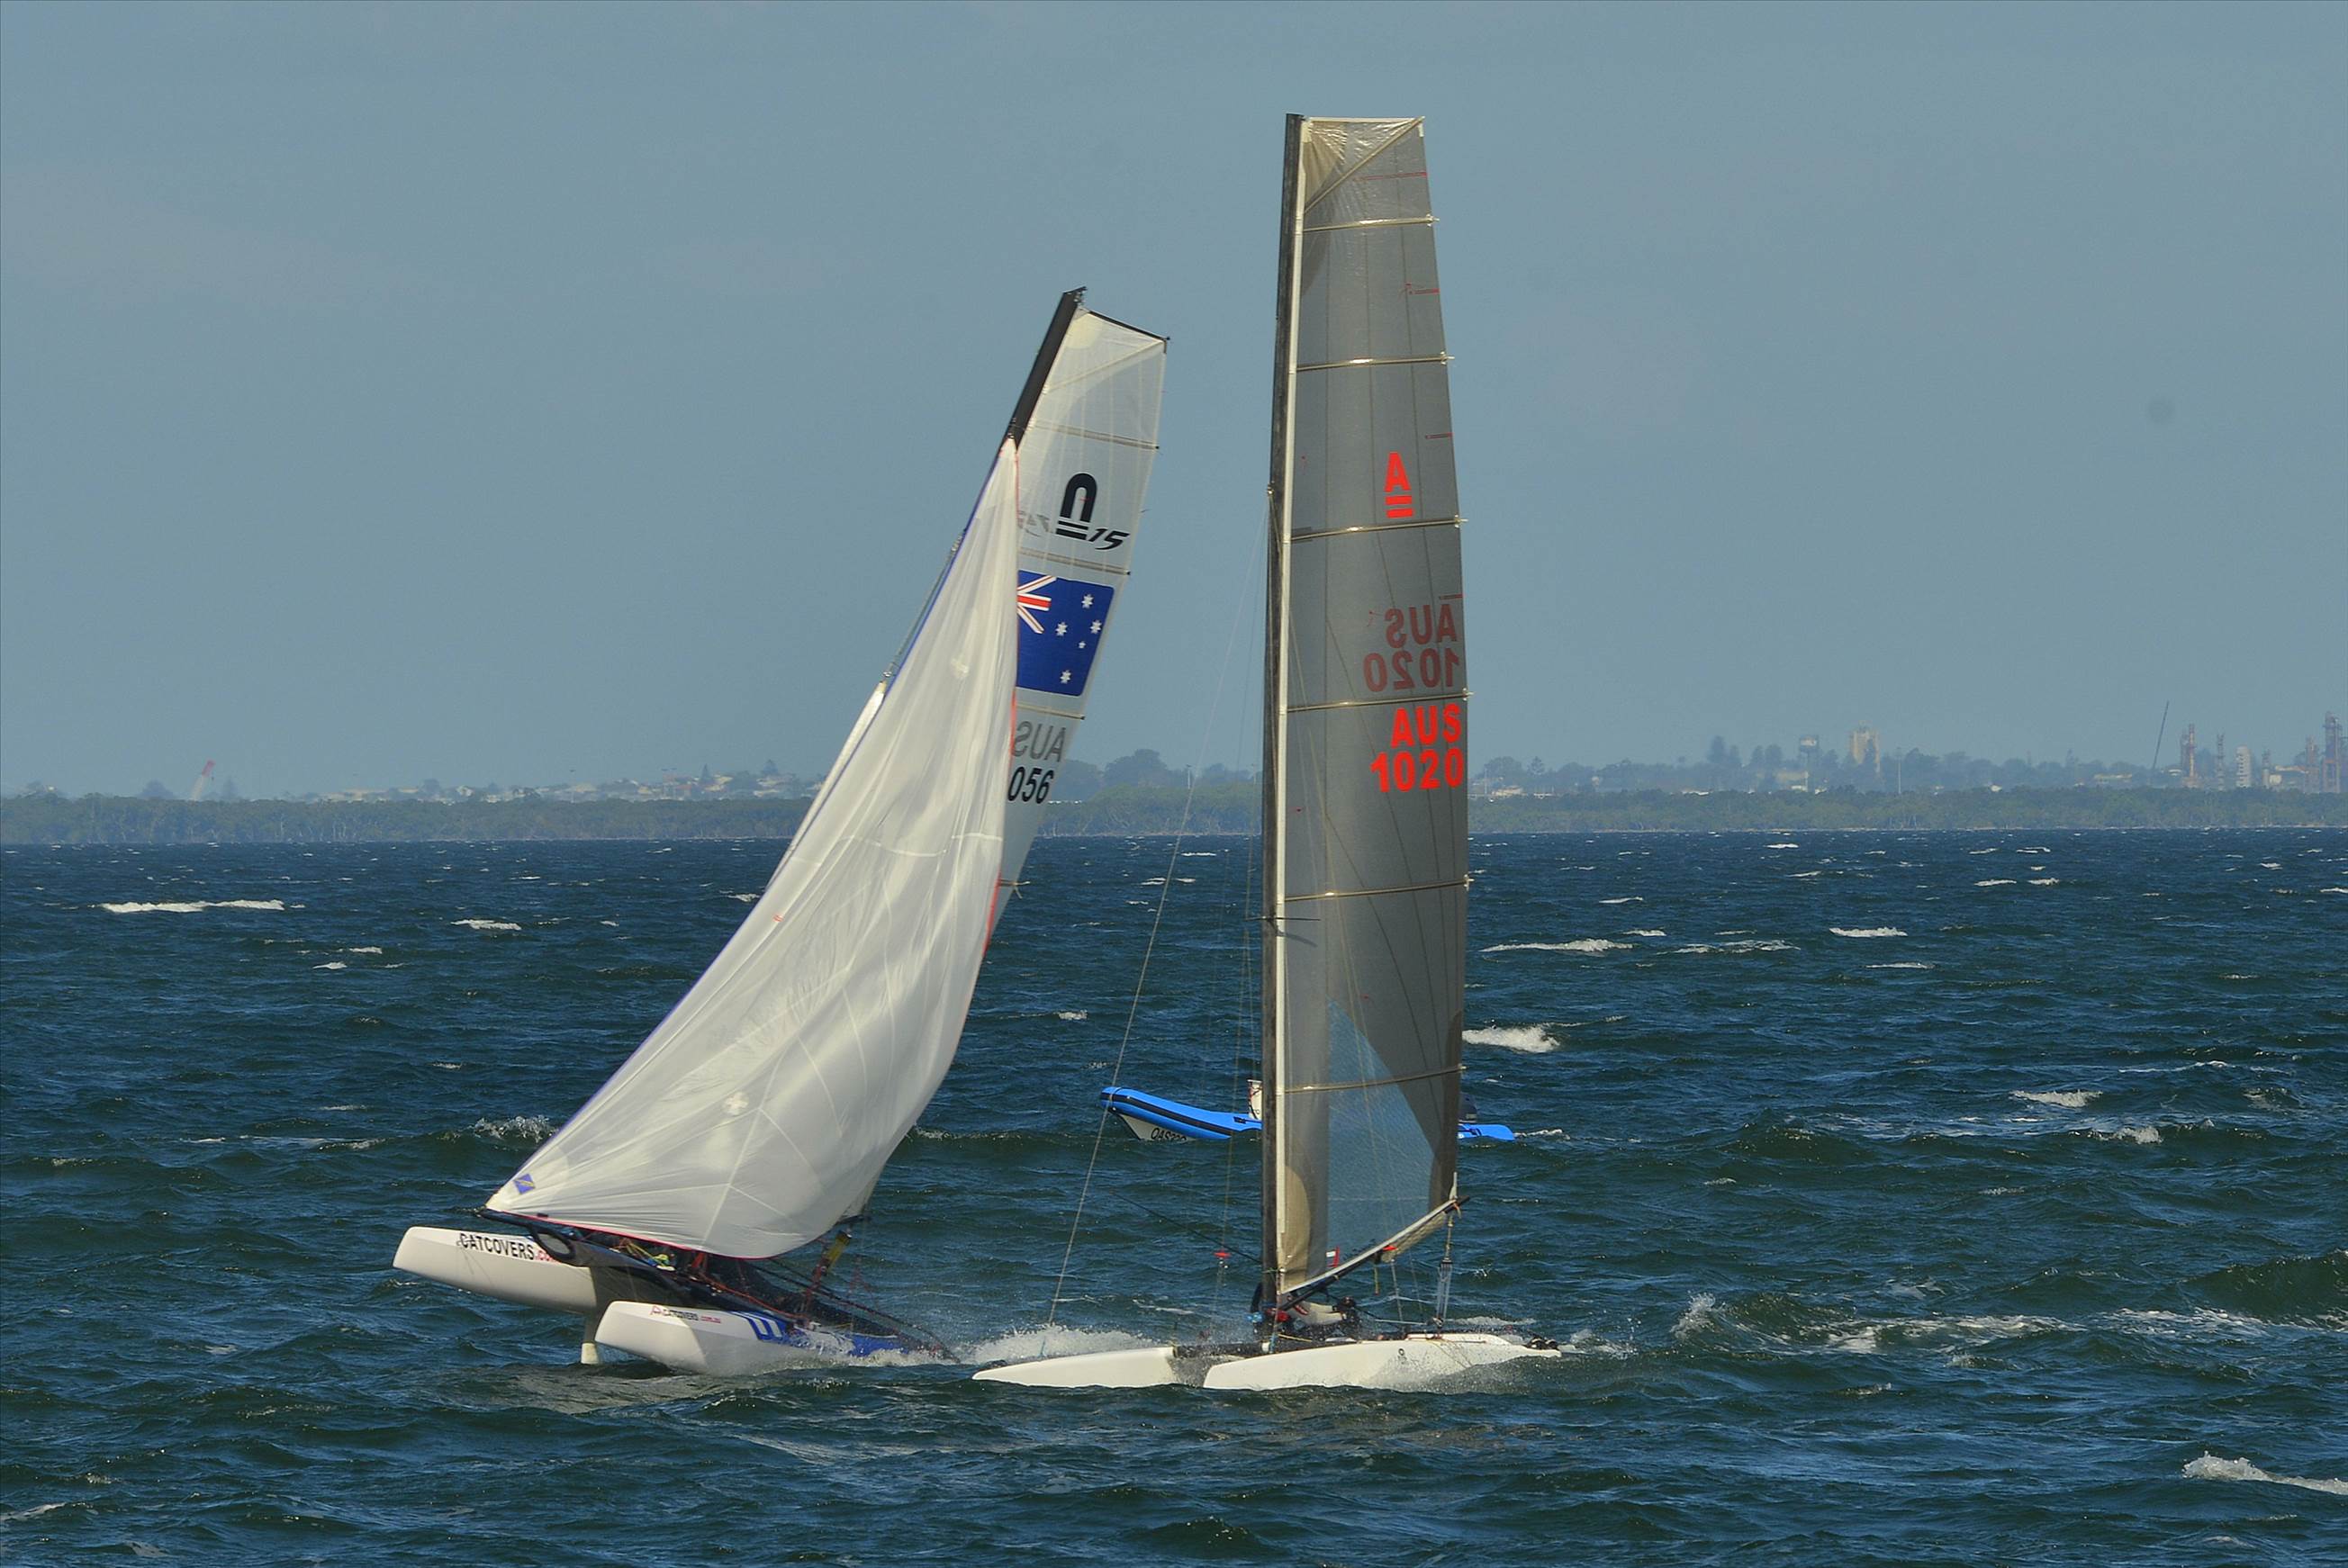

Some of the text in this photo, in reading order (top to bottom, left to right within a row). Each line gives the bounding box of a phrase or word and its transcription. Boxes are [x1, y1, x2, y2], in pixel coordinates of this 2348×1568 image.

[1383, 451, 1412, 492] A
[1088, 527, 1131, 551] 15
[1390, 702, 1462, 748] AUS
[1007, 766, 1054, 804] 056
[1369, 748, 1465, 793] 1020
